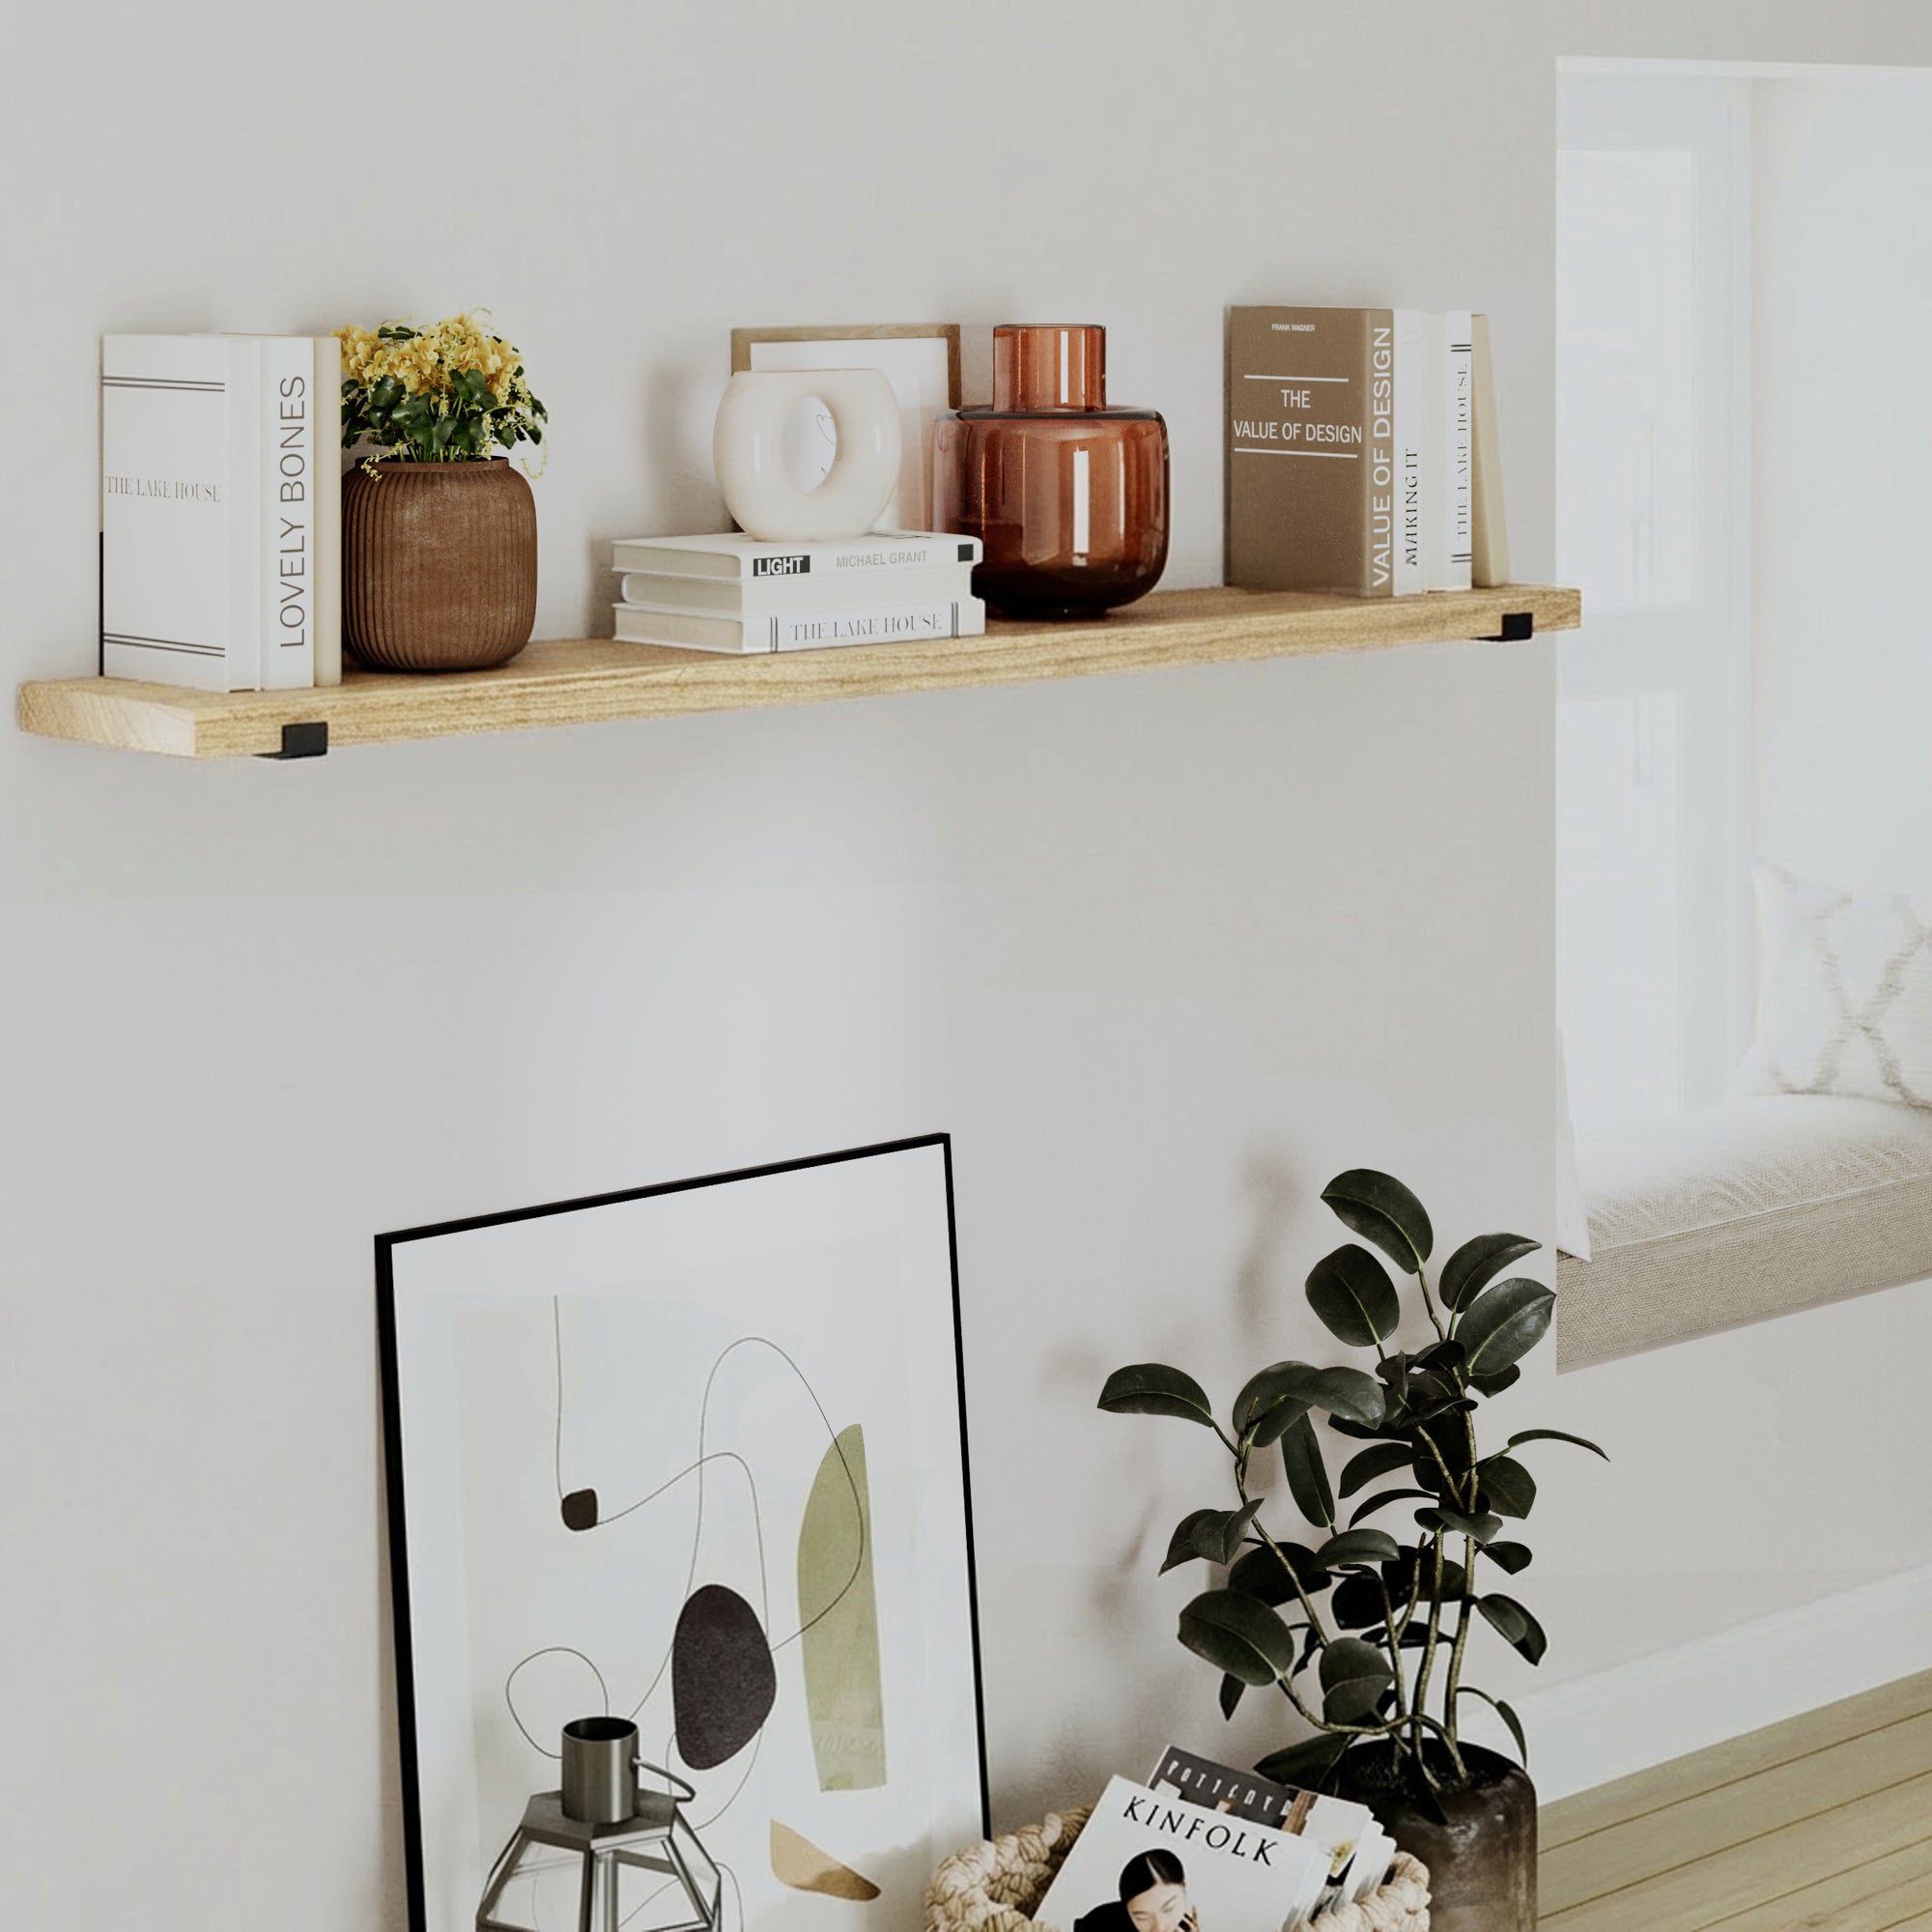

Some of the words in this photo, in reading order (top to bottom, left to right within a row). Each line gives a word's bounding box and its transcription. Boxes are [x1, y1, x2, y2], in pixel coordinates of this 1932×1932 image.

[1271, 323, 1291, 331] FRANK
[1281, 389, 1311, 409] THE
[1373, 327, 1391, 438] DESIGN
[1456, 363, 1467, 431] HOUSE
[279, 376, 305, 502] BONES
[1234, 420, 1278, 440] VALUE
[1282, 422, 1301, 440] OF
[1306, 424, 1362, 443] DESIGN
[1373, 447, 1391, 486] OF
[1405, 448, 1418, 469] IT
[1456, 438, 1467, 491] LAKE
[105, 475, 132, 496] THE
[137, 478, 171, 498] LAKE
[175, 481, 221, 502] HOUSE
[1405, 476, 1418, 566] MAKING
[1456, 498, 1467, 542] THE
[836, 553, 886, 568] MICHAEL
[890, 550, 927, 564] GRANT
[1373, 495, 1391, 587] VALUE
[279, 517, 305, 647] LOVELY
[757, 556, 804, 576] LIGHT
[789, 623, 827, 640] THE
[834, 618, 878, 638] LAKE
[884, 612, 942, 634] HOUSE
[1123, 1795, 1278, 1866] KINFOLK
